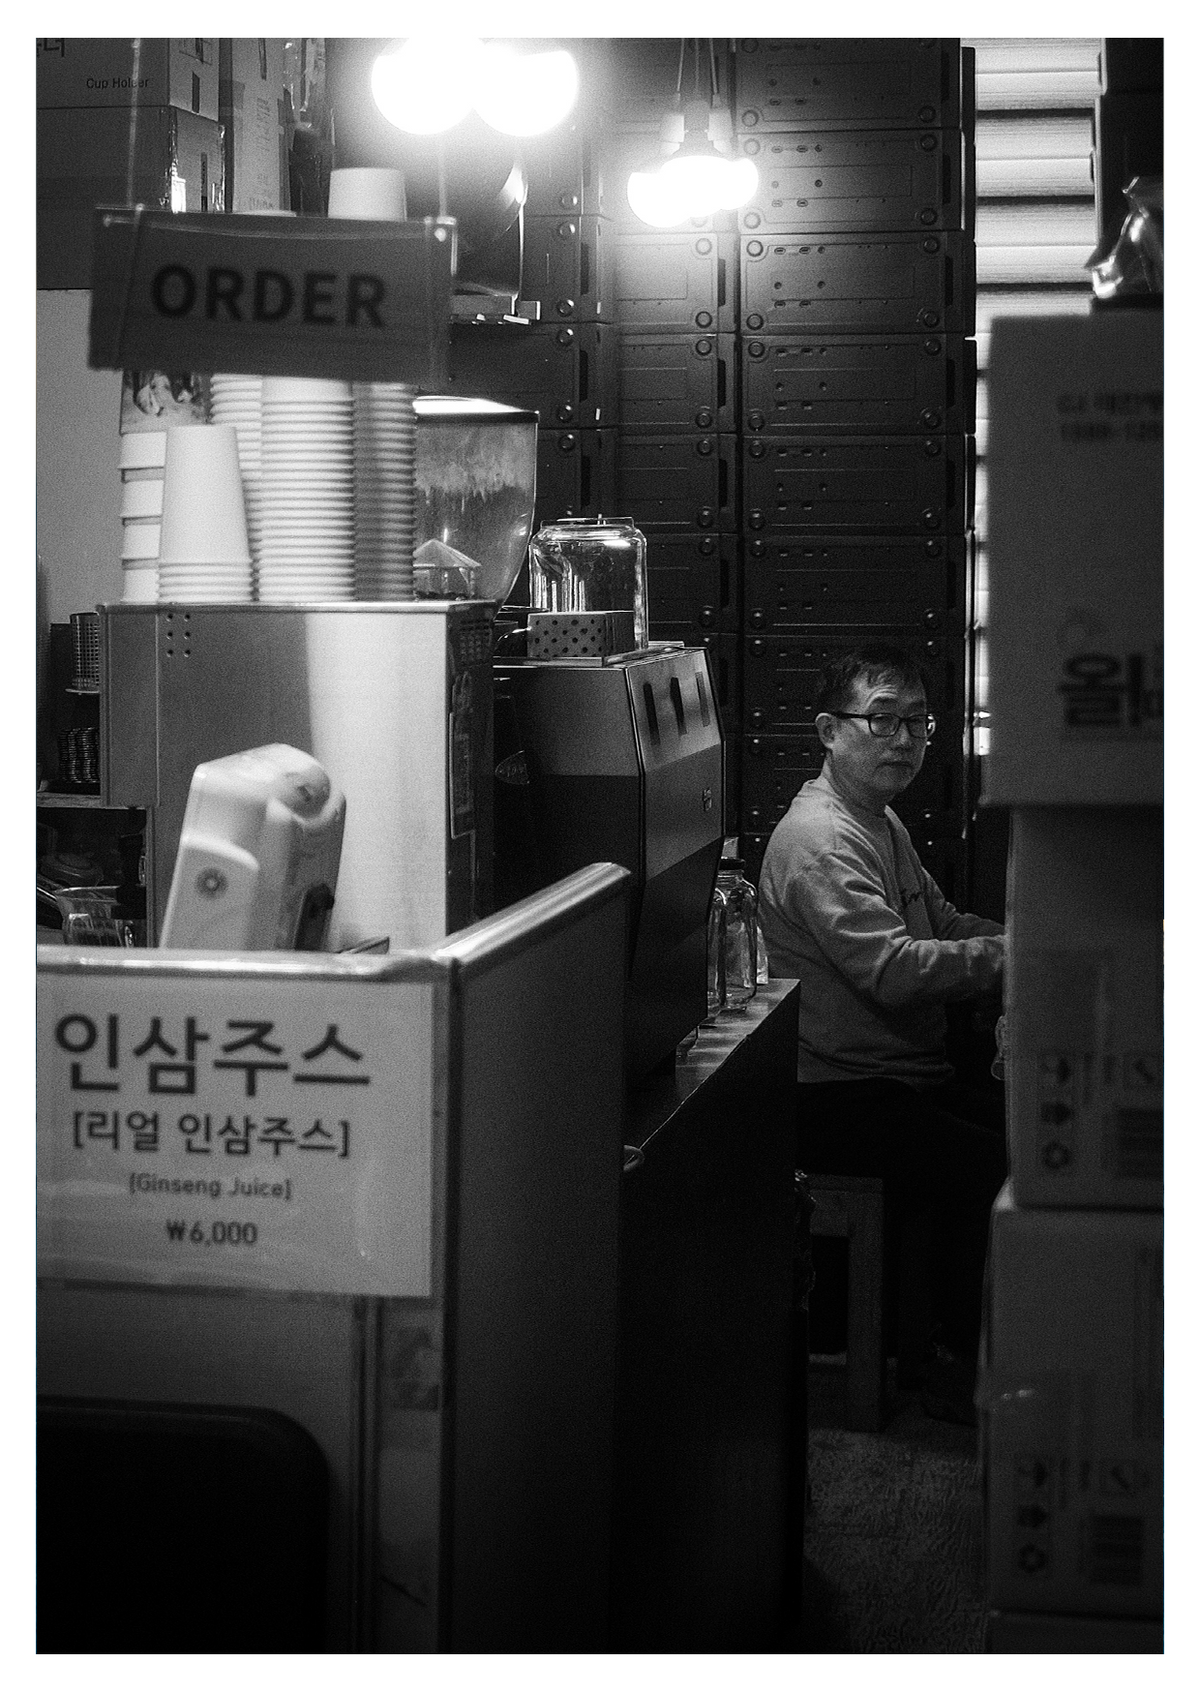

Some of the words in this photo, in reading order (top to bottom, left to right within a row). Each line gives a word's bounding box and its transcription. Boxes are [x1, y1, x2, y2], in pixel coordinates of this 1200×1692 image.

[86, 78, 109, 89] Cup
[152, 264, 386, 328] ORDER
[55, 1013, 371, 1097] 인삼주스
[73, 1111, 159, 1152] [리얼
[178, 1112, 351, 1158] 인삼주스]
